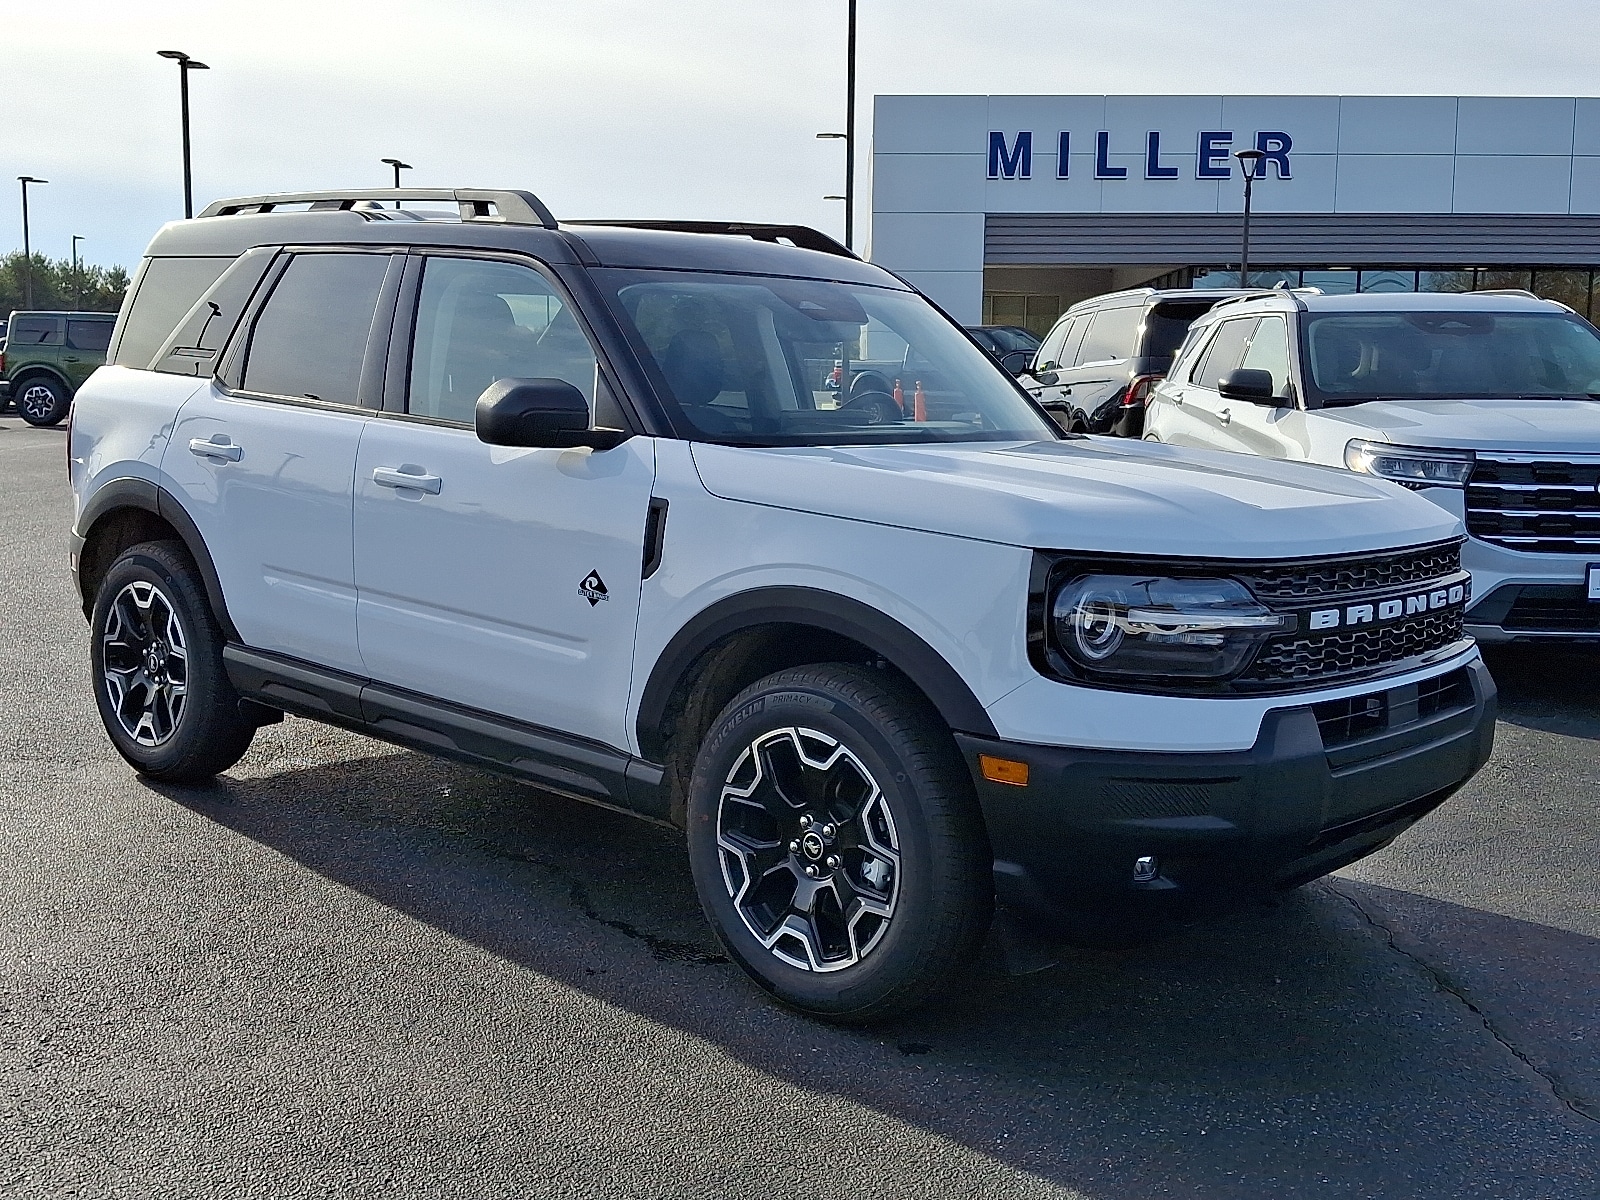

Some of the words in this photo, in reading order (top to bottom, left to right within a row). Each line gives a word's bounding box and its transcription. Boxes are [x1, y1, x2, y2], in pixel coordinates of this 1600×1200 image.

[986, 130, 1293, 180] MILLER
[1310, 585, 1463, 630] BRONCO
[711, 700, 764, 753] MICHELIN
[772, 693, 812, 704] PRIMACY
